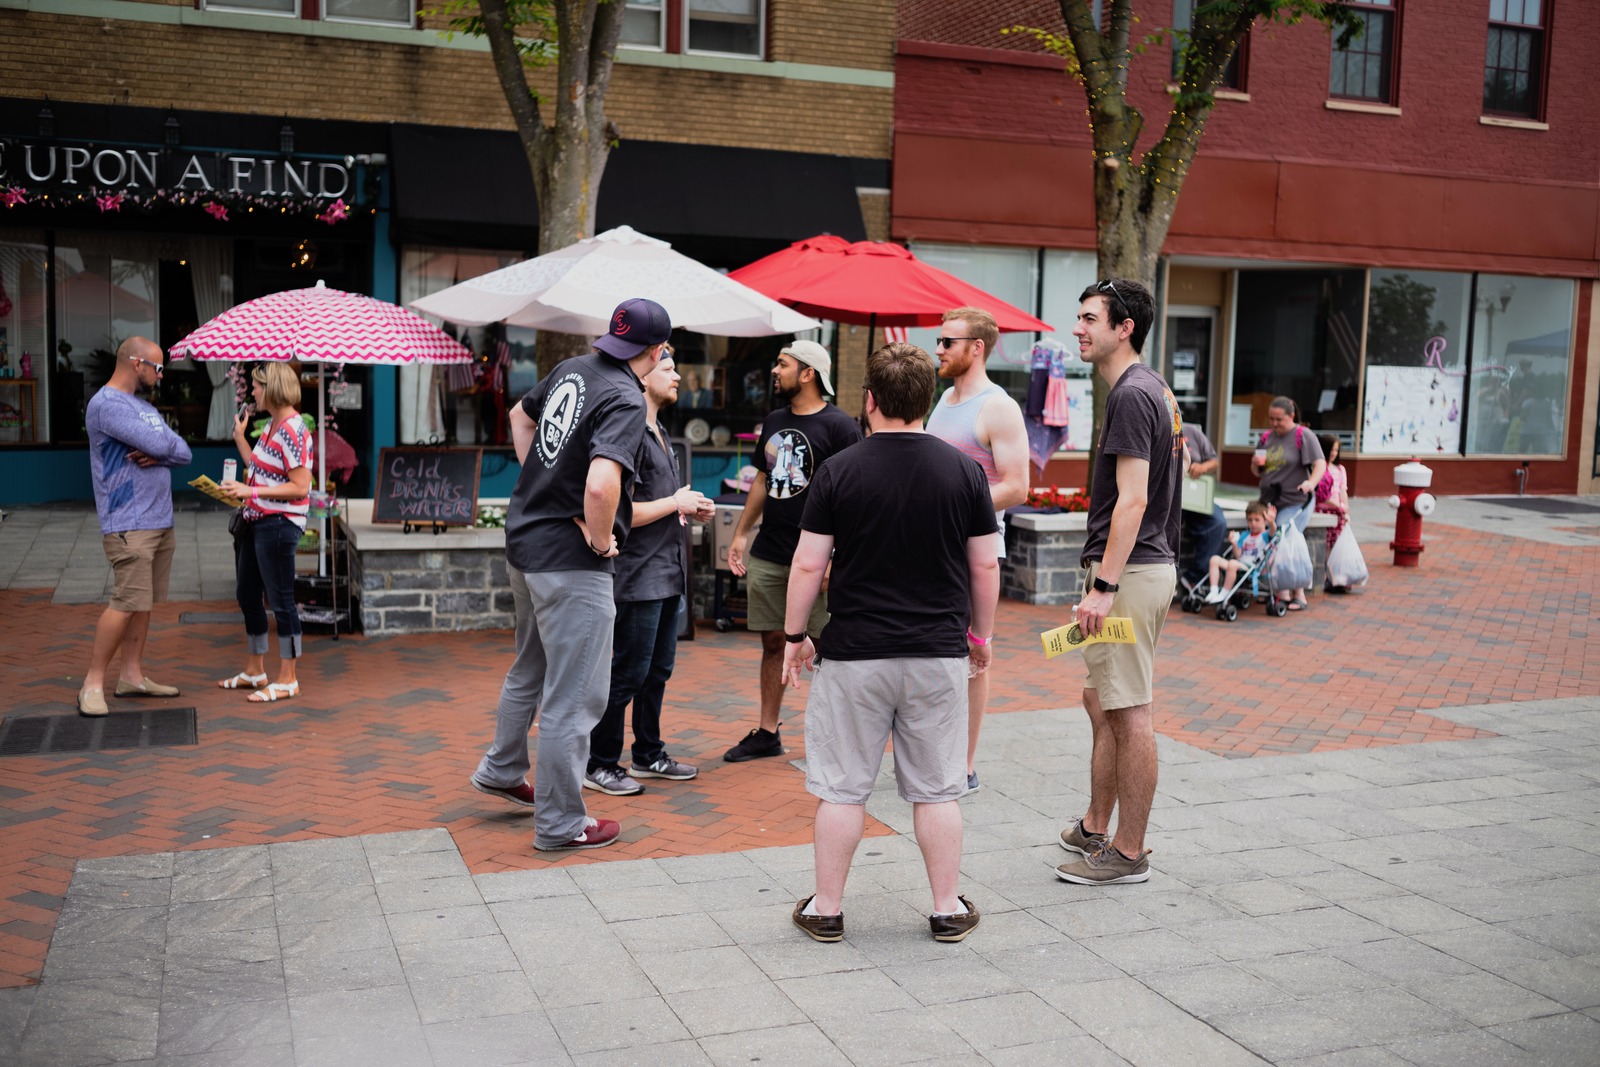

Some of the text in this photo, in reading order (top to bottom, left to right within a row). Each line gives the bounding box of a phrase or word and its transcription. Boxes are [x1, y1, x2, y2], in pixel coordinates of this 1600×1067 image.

[24, 145, 160, 188] UPON
[174, 154, 215, 192] A
[228, 156, 350, 198] FIND
[565, 372, 586, 444] BREWING COMPANY
[390, 456, 441, 479] Cold
[791, 444, 807, 487] NASA
[399, 499, 472, 517] WATER
